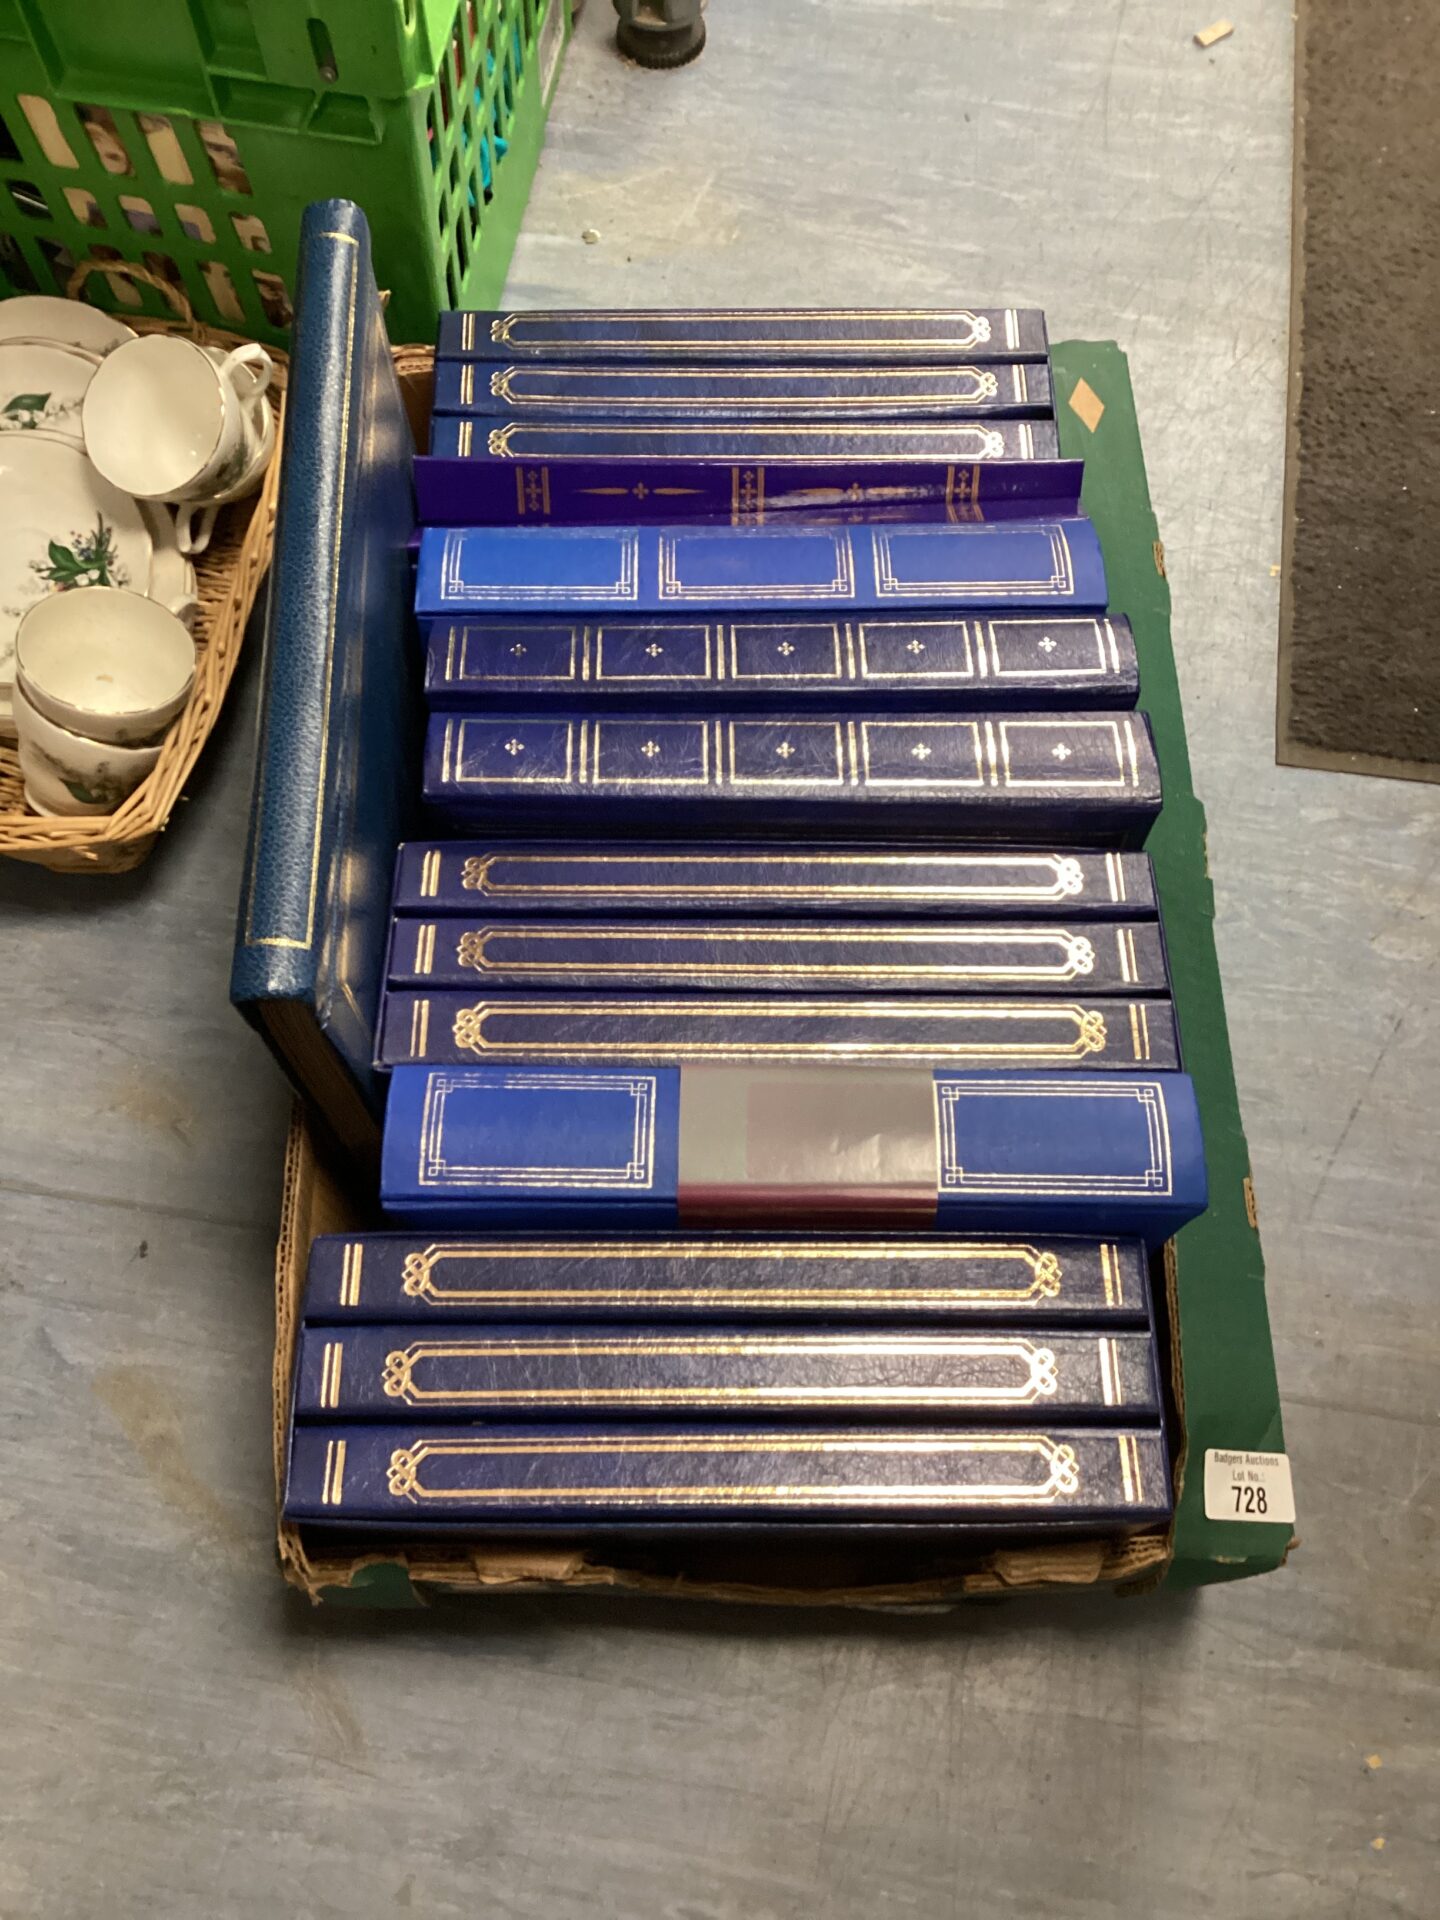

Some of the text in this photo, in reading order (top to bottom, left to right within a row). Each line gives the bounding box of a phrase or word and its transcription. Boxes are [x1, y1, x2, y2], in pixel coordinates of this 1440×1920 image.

[1214, 1452, 1279, 1467] Badgers Auctions
[1232, 1469, 1245, 1482] Lot
[1231, 1486, 1268, 1514] 728
